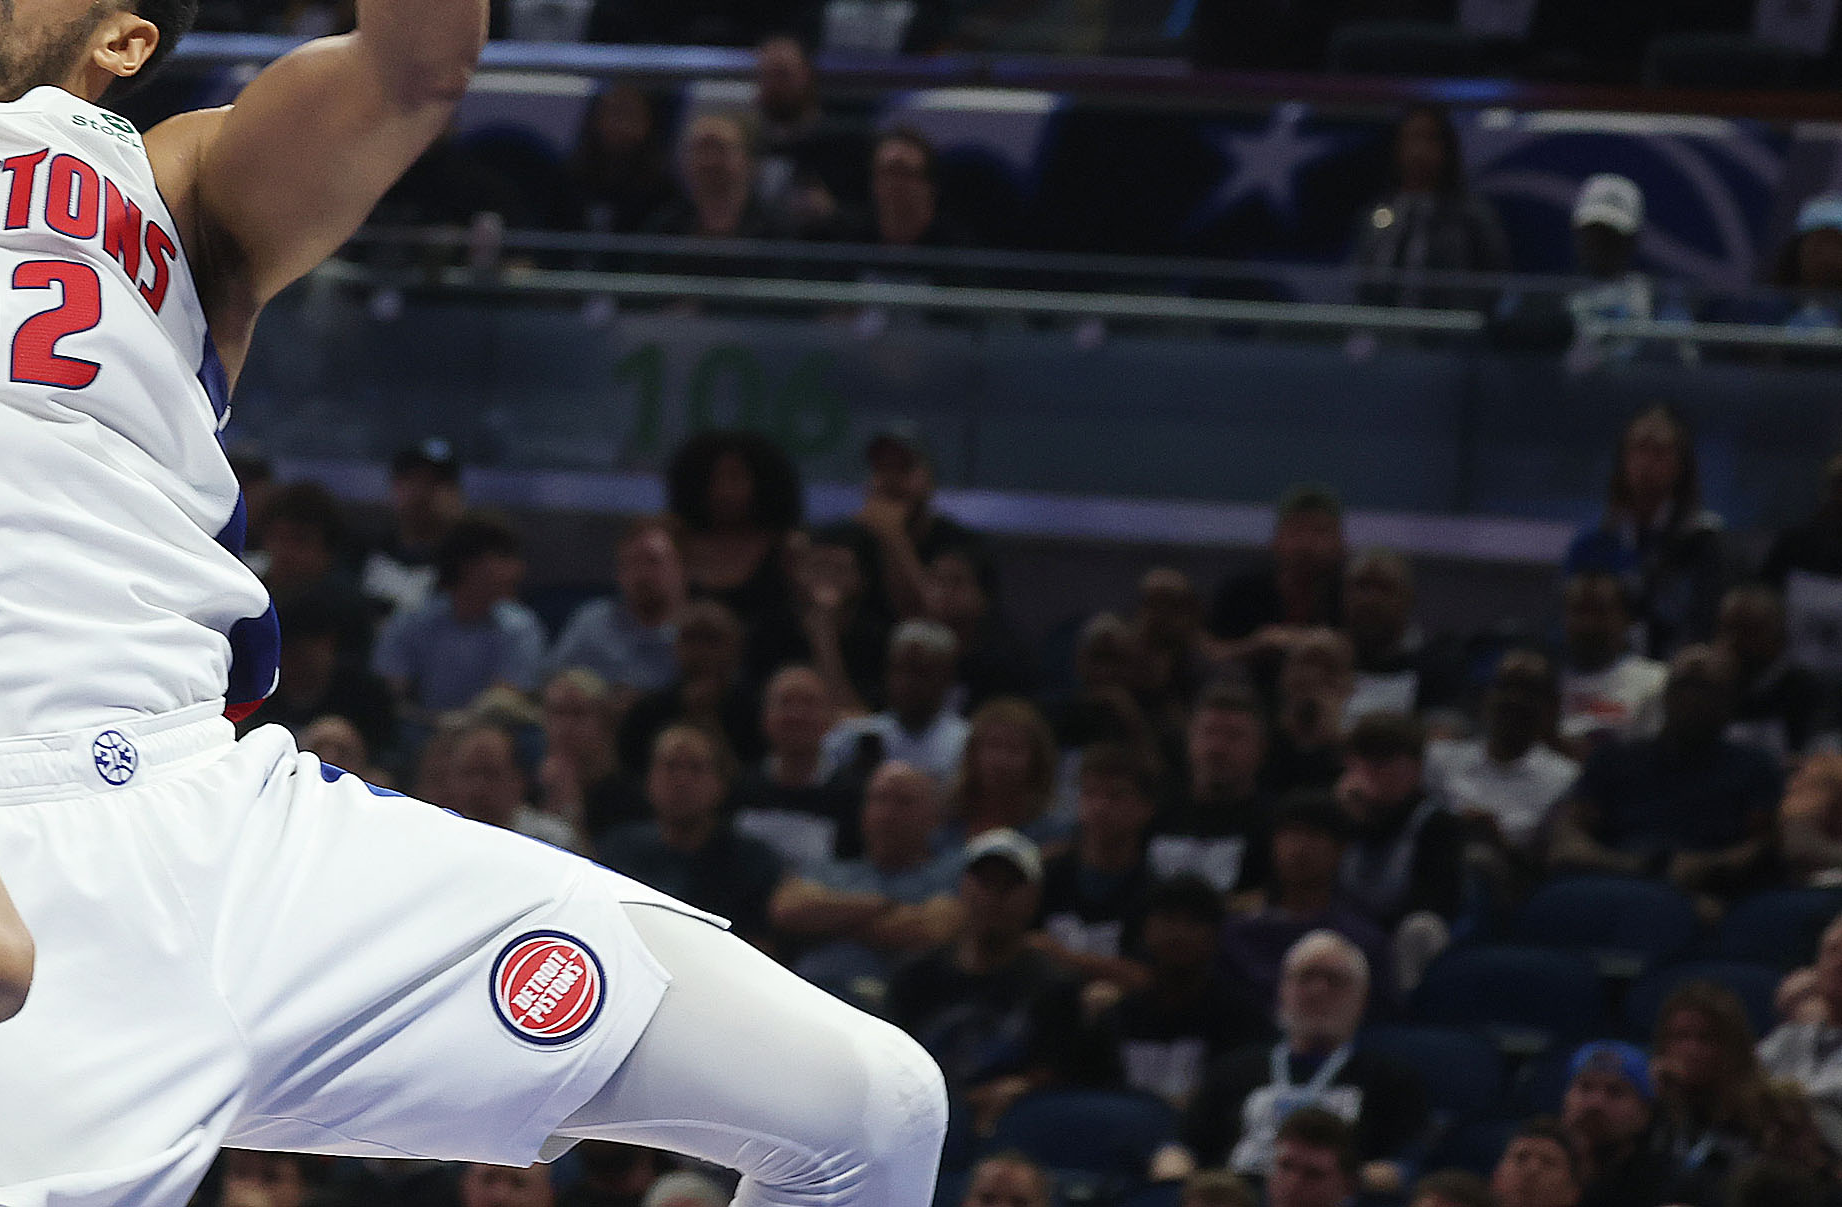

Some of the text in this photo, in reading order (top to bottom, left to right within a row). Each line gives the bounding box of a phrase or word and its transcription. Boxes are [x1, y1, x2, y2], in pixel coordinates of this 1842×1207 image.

[612, 344, 850, 456] 106
[510, 948, 585, 1024] DETROIT PISTONS
